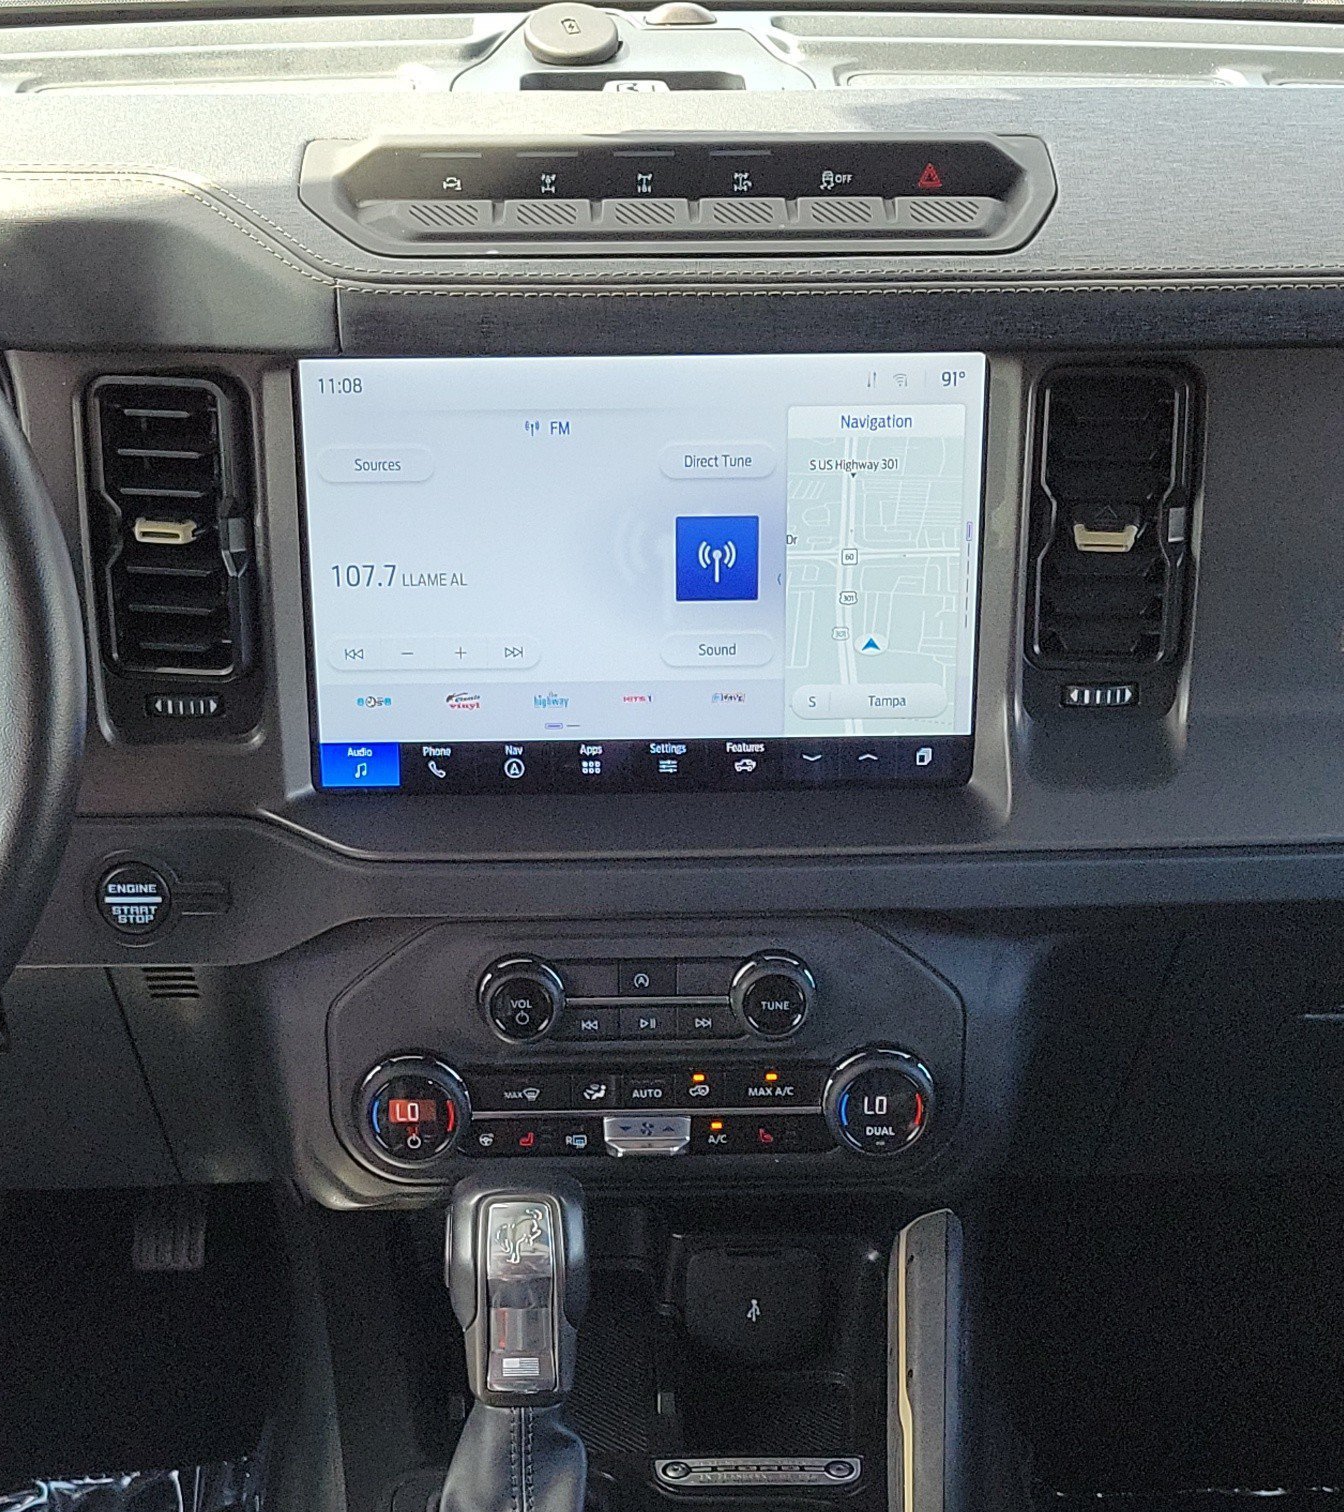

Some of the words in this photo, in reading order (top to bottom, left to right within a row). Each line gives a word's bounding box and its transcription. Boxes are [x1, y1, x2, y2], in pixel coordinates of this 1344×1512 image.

[835, 174, 853, 184] OFF
[318, 378, 363, 394] 11:08
[550, 421, 571, 435] FM
[840, 414, 913, 431] Navigation
[354, 458, 401, 471] Sources
[684, 455, 720, 468] Direct
[722, 455, 753, 468] Tune
[809, 460, 817, 471] S
[818, 460, 834, 471] US
[835, 459, 880, 473] Highway
[881, 458, 899, 470] 301
[331, 564, 397, 588] 107.7
[402, 573, 447, 588] LLAME
[450, 572, 468, 587] AL
[698, 643, 737, 656] Sound
[808, 696, 817, 708] S
[868, 695, 907, 709] Tampa
[347, 747, 373, 757] Audio
[422, 746, 452, 757] Phone
[505, 745, 524, 755] Nav
[579, 744, 603, 756] Apps
[650, 743, 687, 755] Settings
[726, 741, 765, 753] Features
[108, 883, 157, 894] ENGINE
[112, 905, 158, 915] START
[117, 915, 155, 924] STOP
[511, 1000, 533, 1009] VOL
[761, 1001, 790, 1011] TUNE
[632, 1088, 662, 1099] AUTO
[748, 1087, 772, 1097] MAX
[774, 1086, 795, 1097] A/C
[864, 1096, 888, 1115] LO
[396, 1103, 419, 1122] LO
[866, 1126, 895, 1136] DUAL
[708, 1134, 728, 1144] A/C
